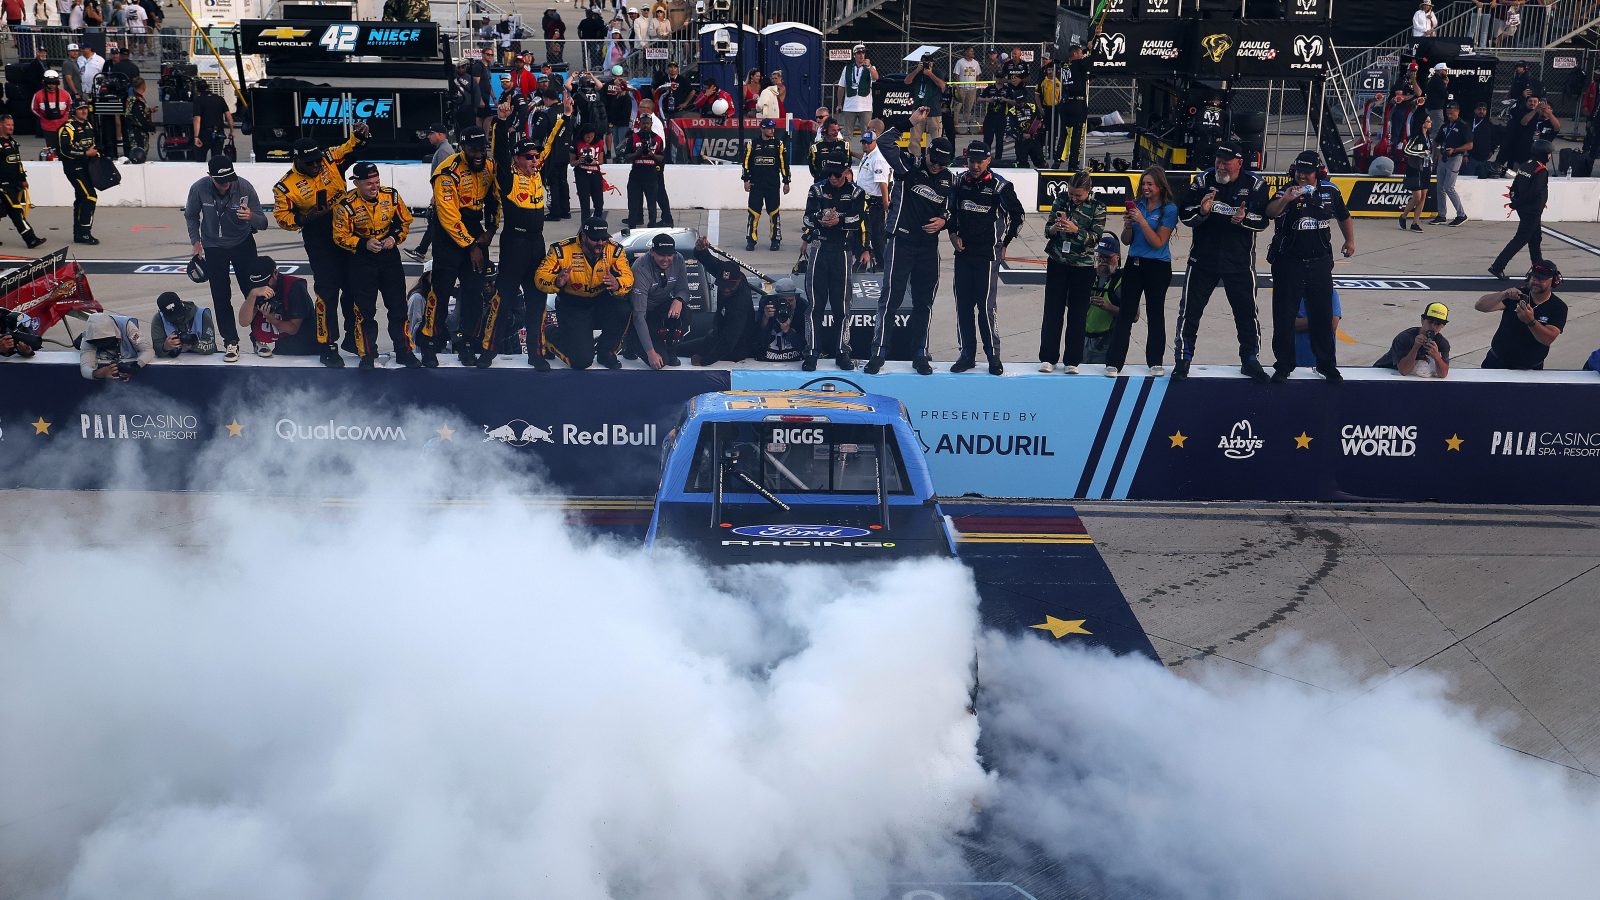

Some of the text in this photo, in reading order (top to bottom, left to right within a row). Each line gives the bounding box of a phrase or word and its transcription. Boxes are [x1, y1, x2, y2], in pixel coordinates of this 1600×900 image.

[319, 23, 360, 52] 42
[1142, 40, 1174, 48] KAULIG
[1140, 48, 1171, 56] RACING
[1239, 41, 1271, 49] KAULIG
[1236, 49, 1269, 57] RACING
[1446, 67, 1492, 78] mpers inn
[1478, 75, 1491, 83] RV
[692, 119, 706, 127] DO
[708, 119, 728, 127] NT
[1092, 186, 1126, 195] AM
[1, 253, 64, 289] FORD RACING
[725, 253, 766, 278] CHEVROLET
[920, 410, 1037, 422] PRESENTED BY
[80, 413, 198, 439] PALA CASINO
[275, 418, 407, 443] Qualcomm
[1341, 424, 1418, 440] CAMPING
[131, 430, 198, 440] SPA RESORT
[563, 423, 657, 446] Red Bull
[772, 428, 824, 444] RIGGS
[934, 433, 1055, 457] ANDURIL
[1340, 438, 1416, 457] WORLD
[1490, 431, 1537, 456] PALA
[1538, 447, 1600, 457] SPA RESORT
[740, 473, 762, 490] FORD
[761, 488, 791, 511] RACING
[764, 525, 842, 538] Ford
